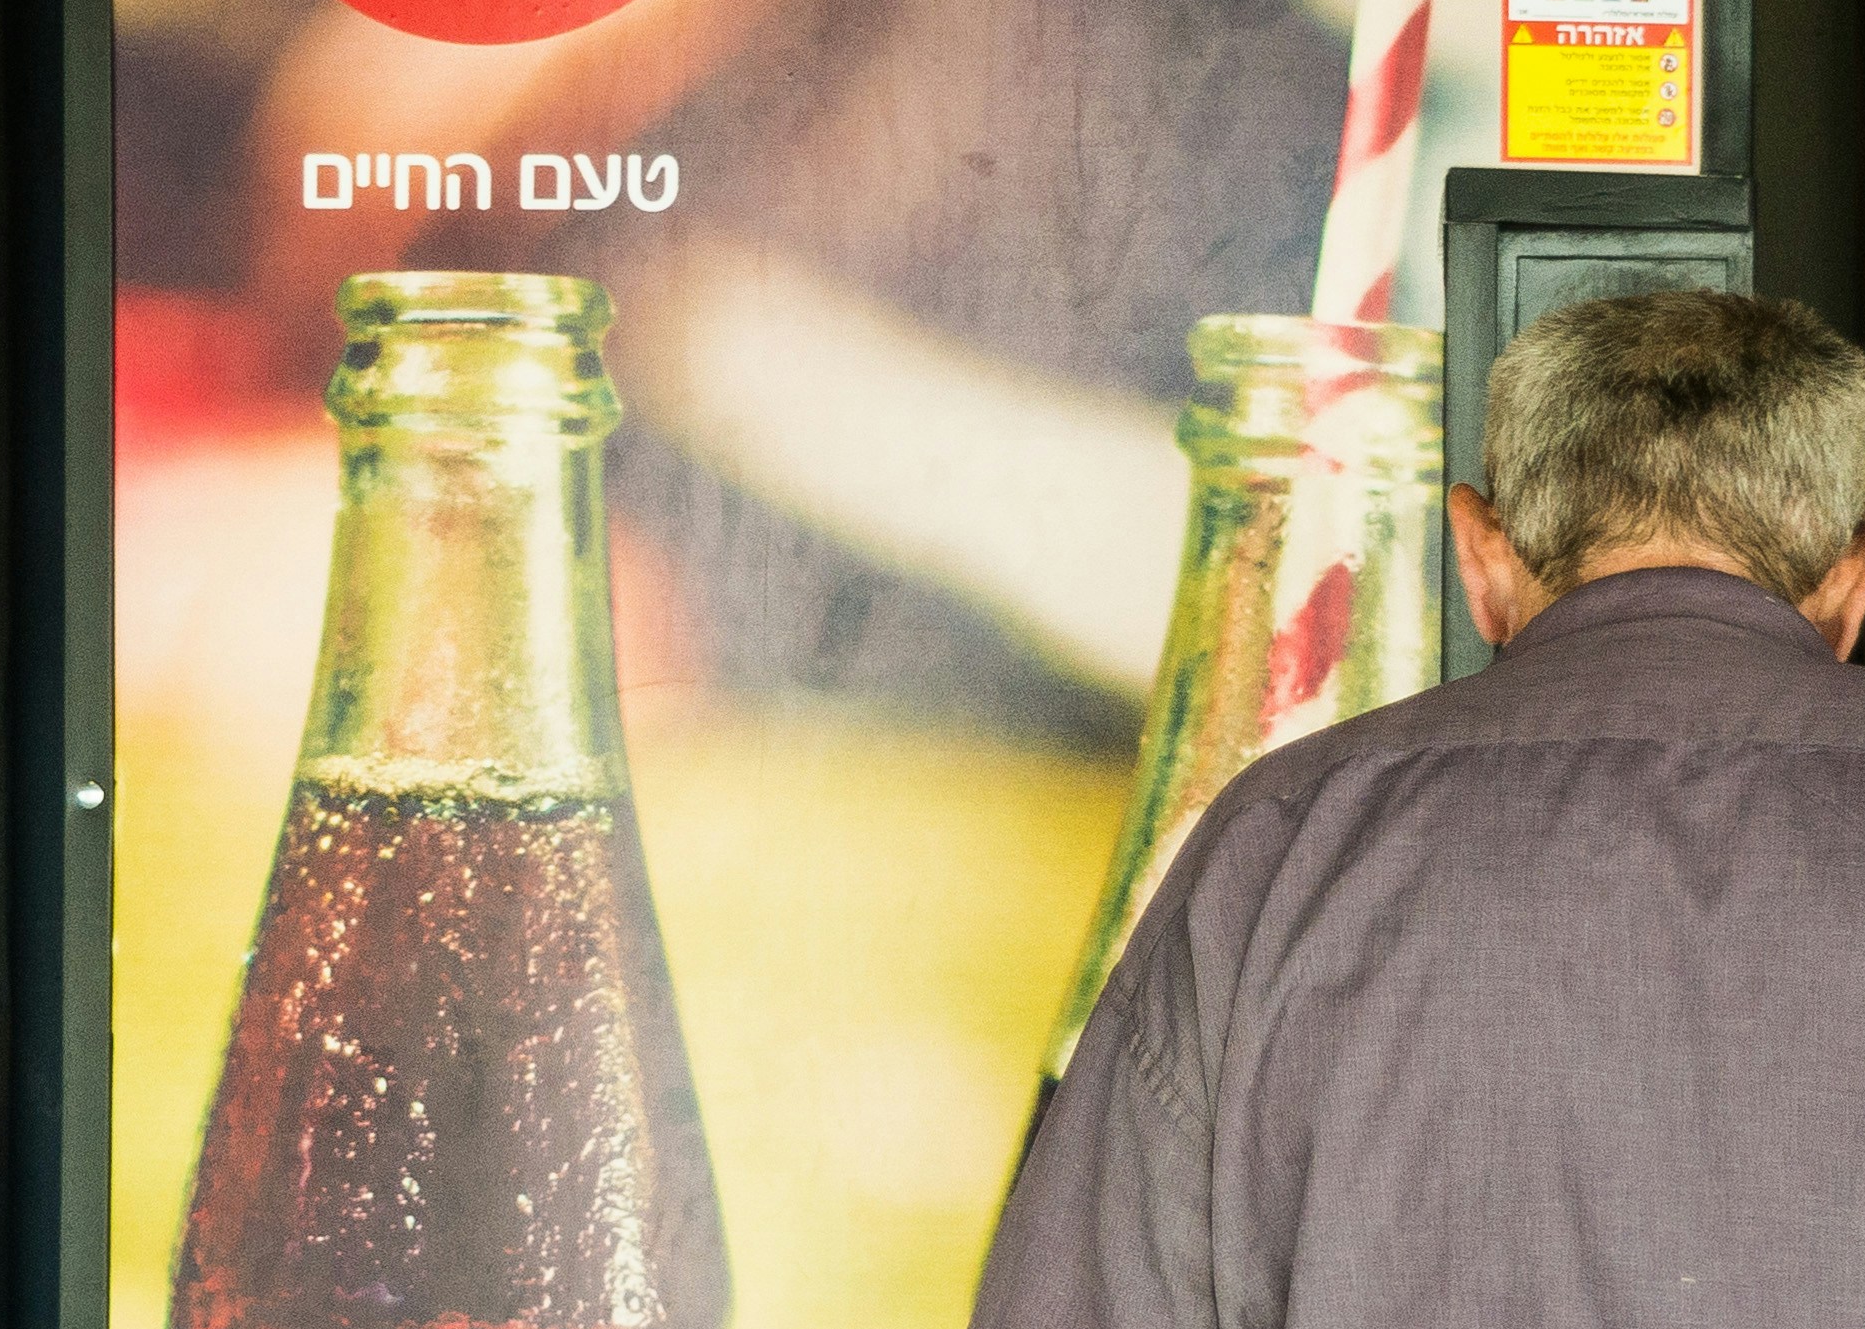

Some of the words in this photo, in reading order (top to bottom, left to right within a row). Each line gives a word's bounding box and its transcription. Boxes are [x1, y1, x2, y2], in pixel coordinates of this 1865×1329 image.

[1555, 24, 1645, 46] אזהרה
[302, 153, 492, 212] החיים
[520, 153, 680, 213] טעם
